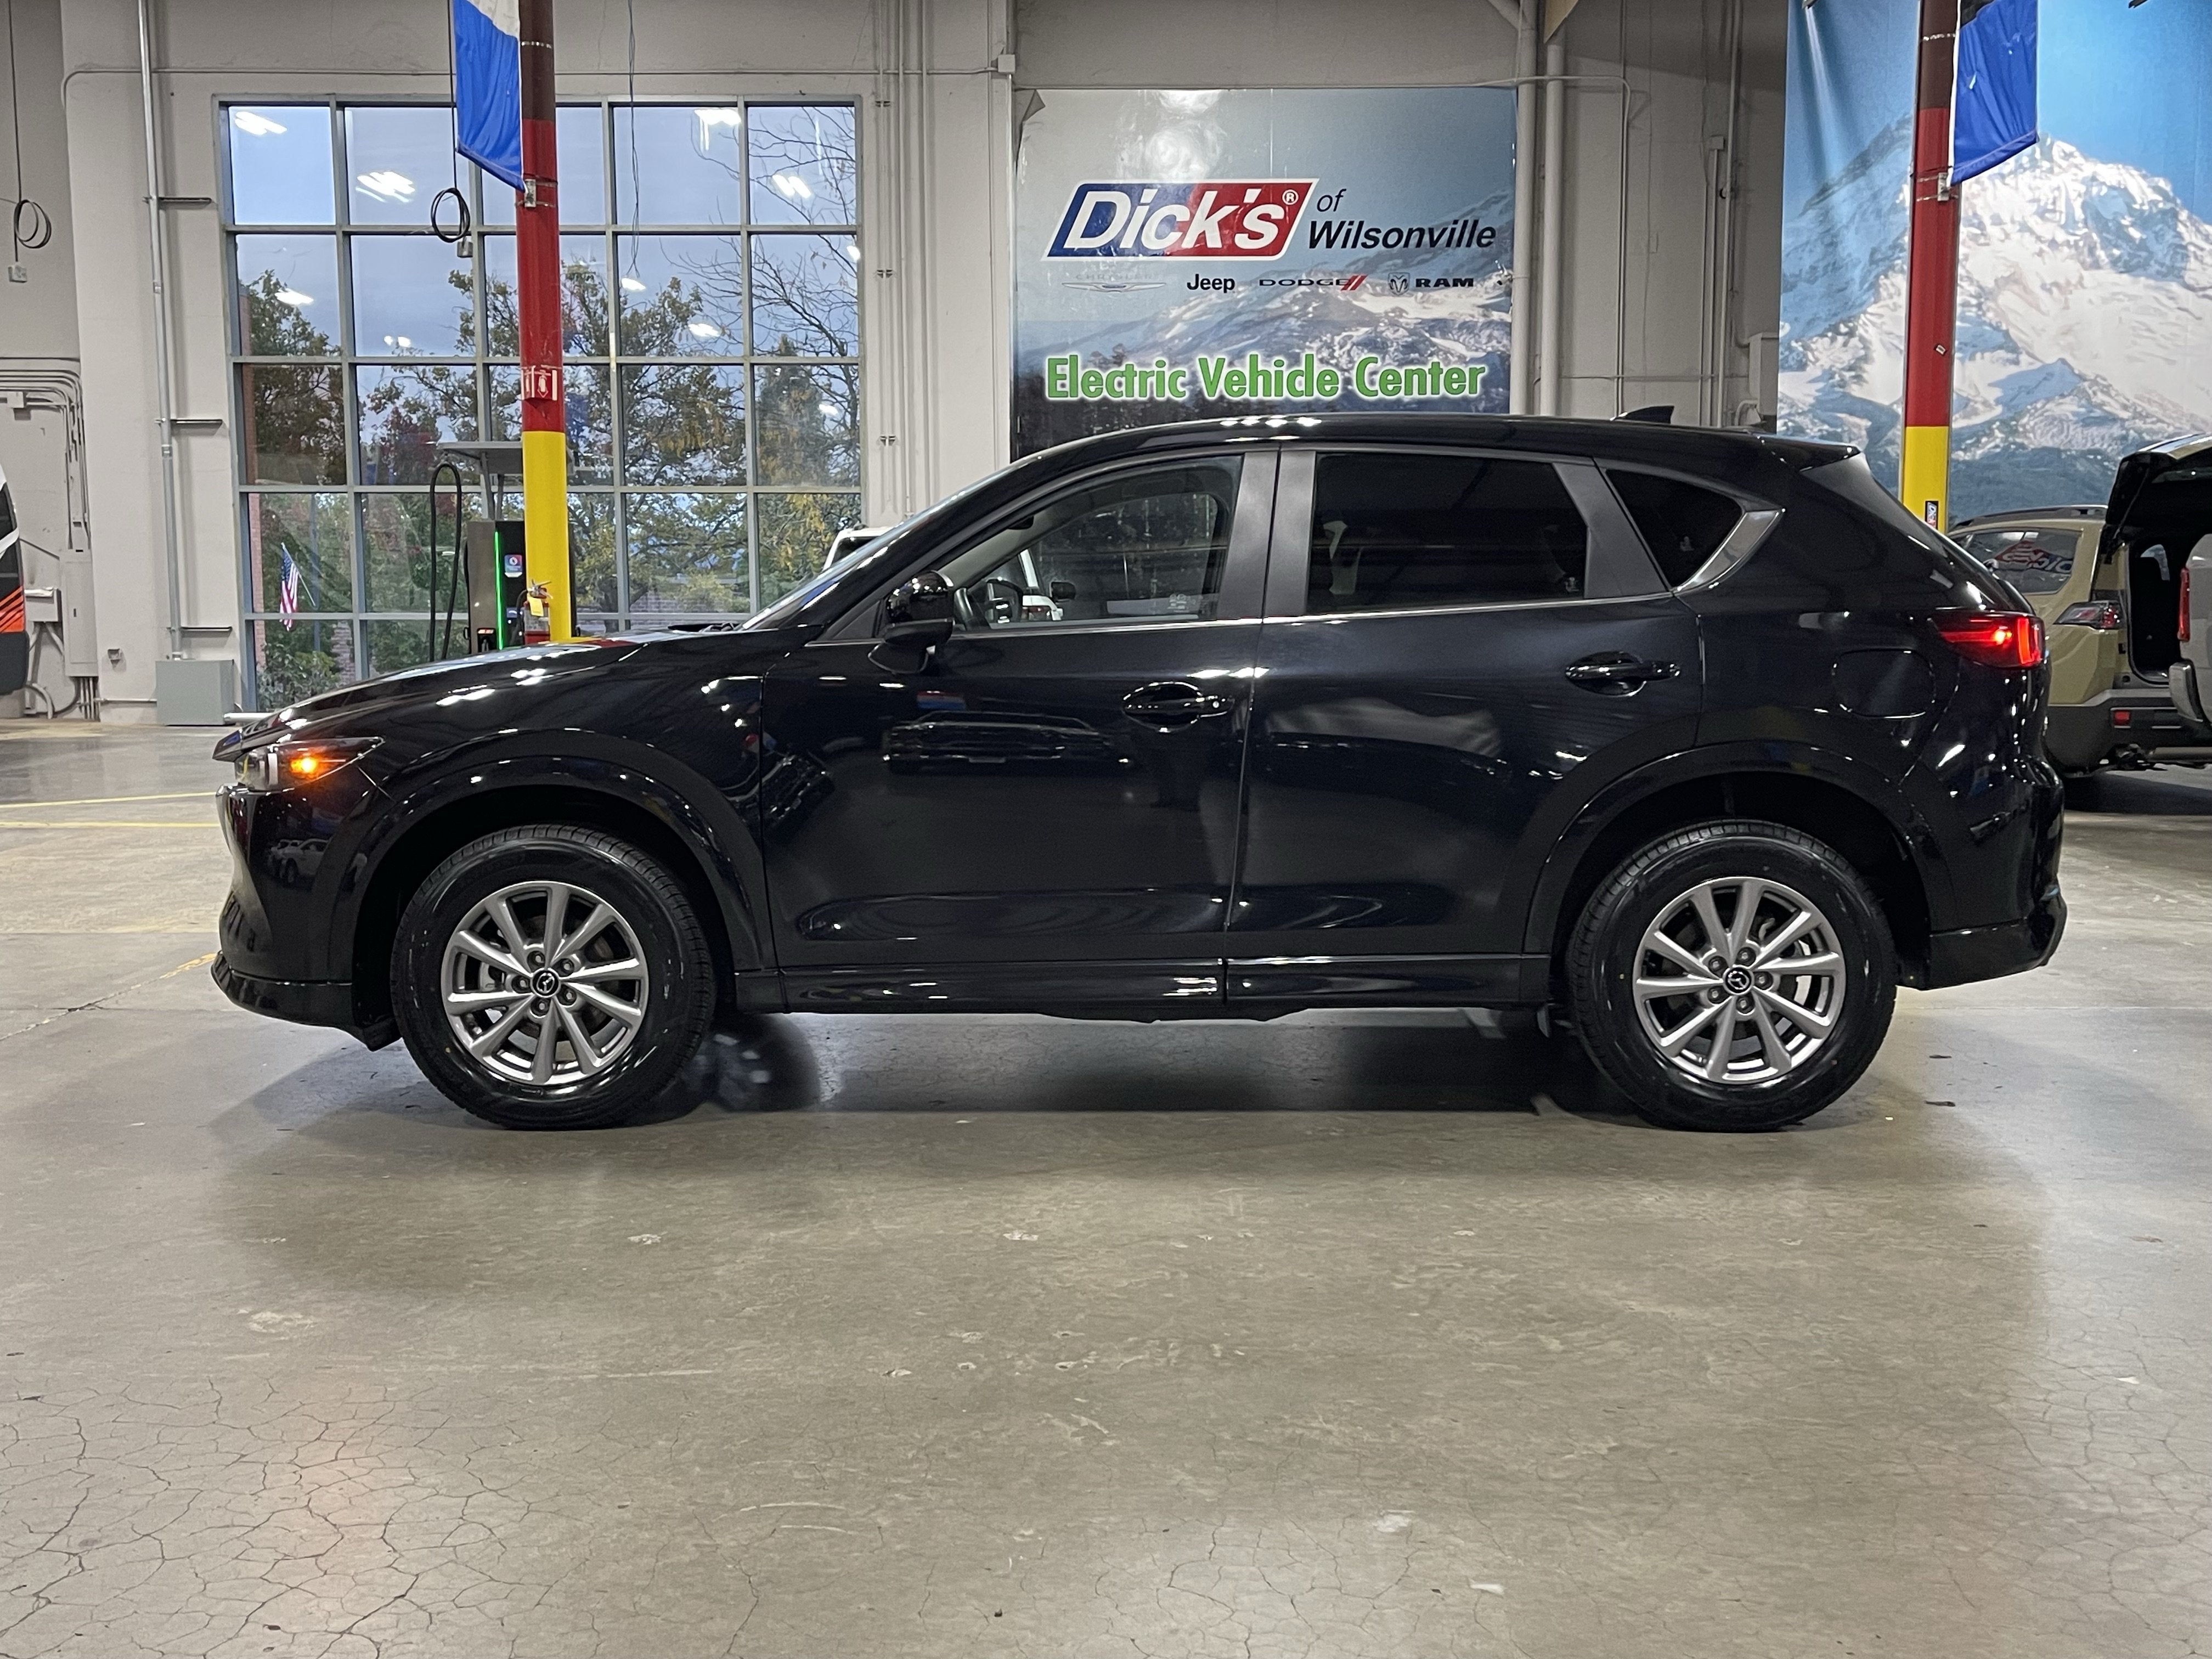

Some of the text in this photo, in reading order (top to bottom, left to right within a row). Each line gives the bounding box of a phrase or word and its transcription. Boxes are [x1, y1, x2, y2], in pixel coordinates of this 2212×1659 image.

[1317, 188, 1347, 212] of
[1308, 219, 1497, 249] Wilsonville
[1186, 273, 1235, 294] Jeep
[1259, 278, 1352, 287] DODGE
[1415, 278, 1474, 287] RAM
[1047, 353, 1486, 399] Electric Vehicle Center
